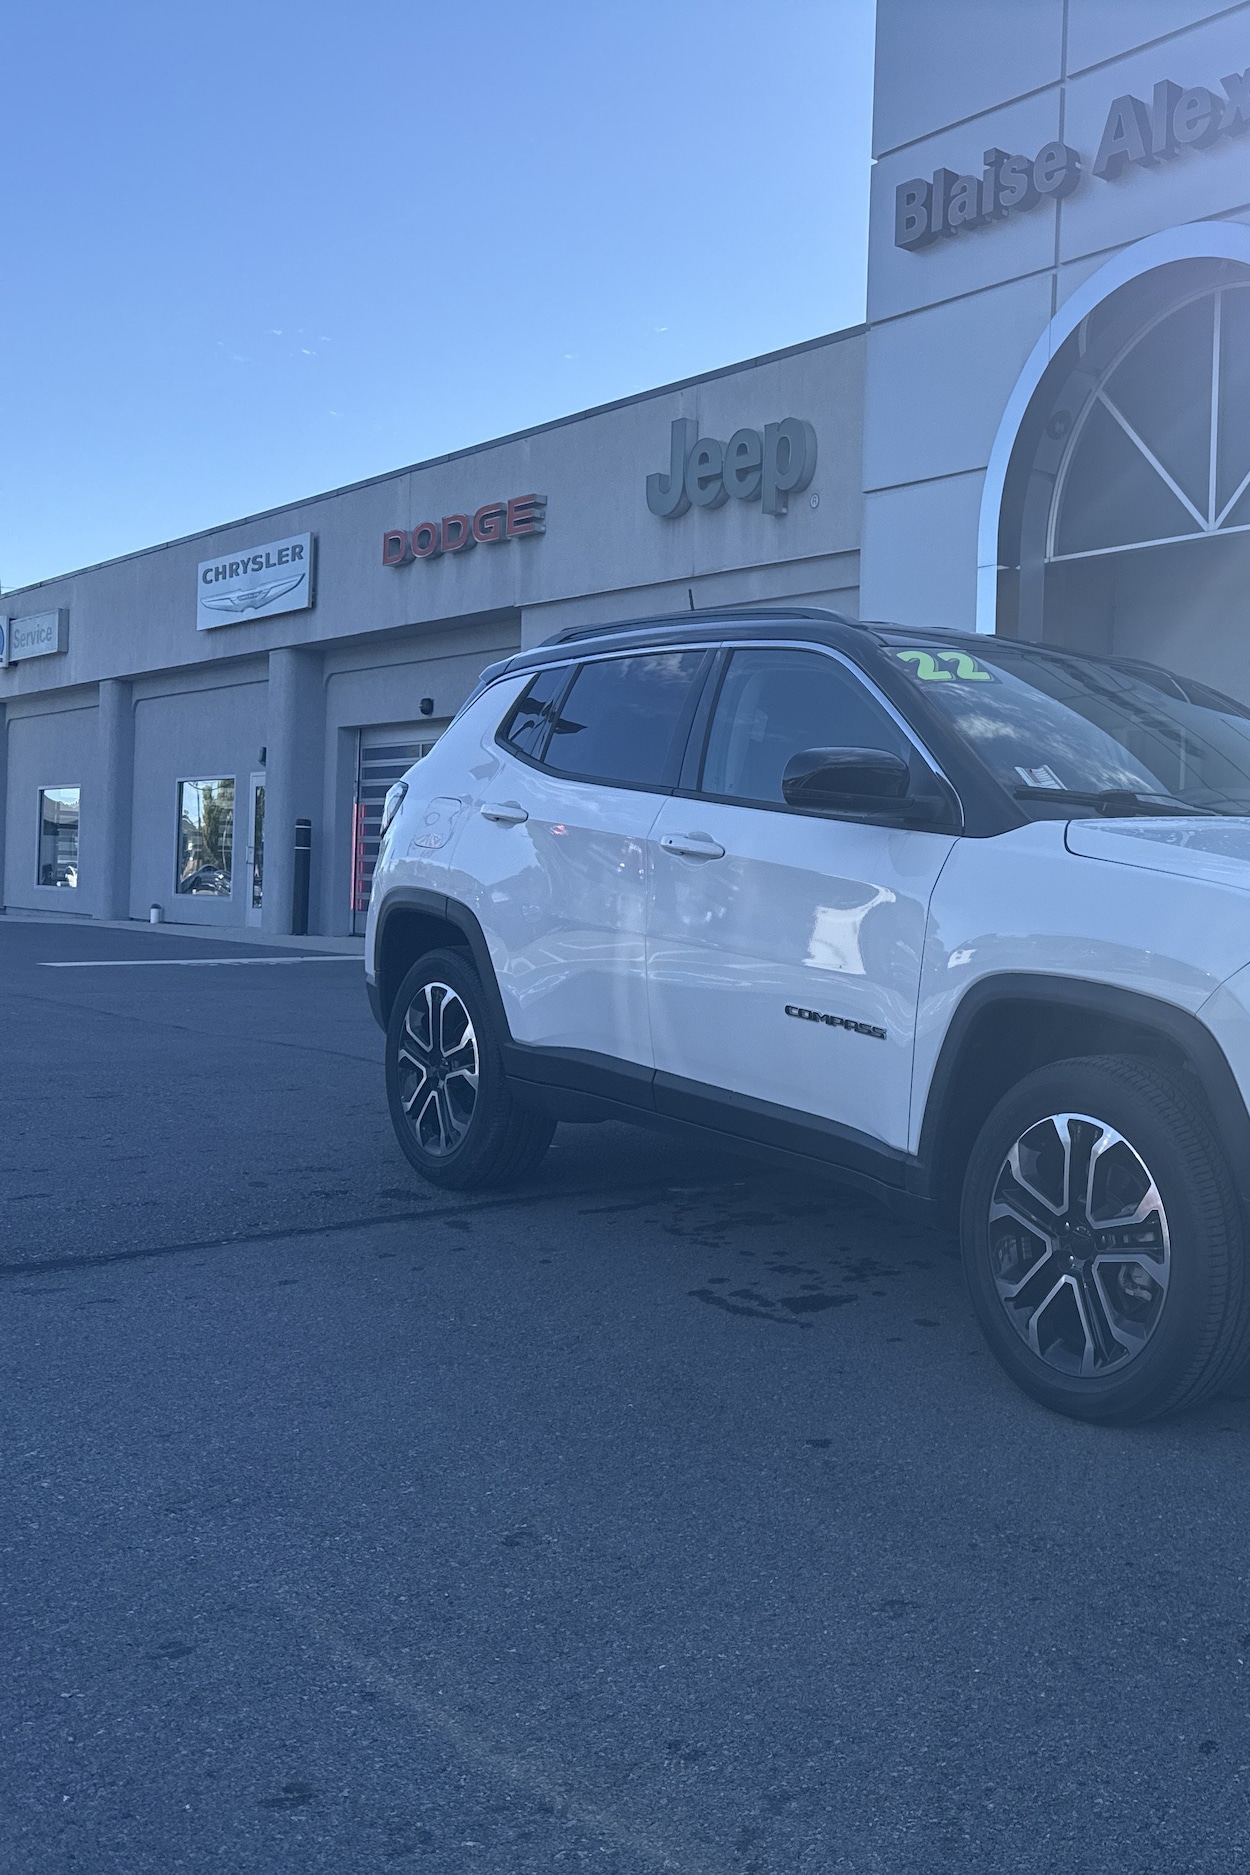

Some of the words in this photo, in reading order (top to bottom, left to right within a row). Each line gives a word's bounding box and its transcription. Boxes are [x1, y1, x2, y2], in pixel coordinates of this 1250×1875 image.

[894, 141, 1080, 251] Blaise
[645, 416, 818, 519] Jeep
[382, 493, 547, 567] DODGE
[201, 543, 305, 585] CHRYSLER
[13, 623, 53, 650] Service
[896, 650, 995, 682] 22
[784, 1004, 888, 1041] COMPASS
